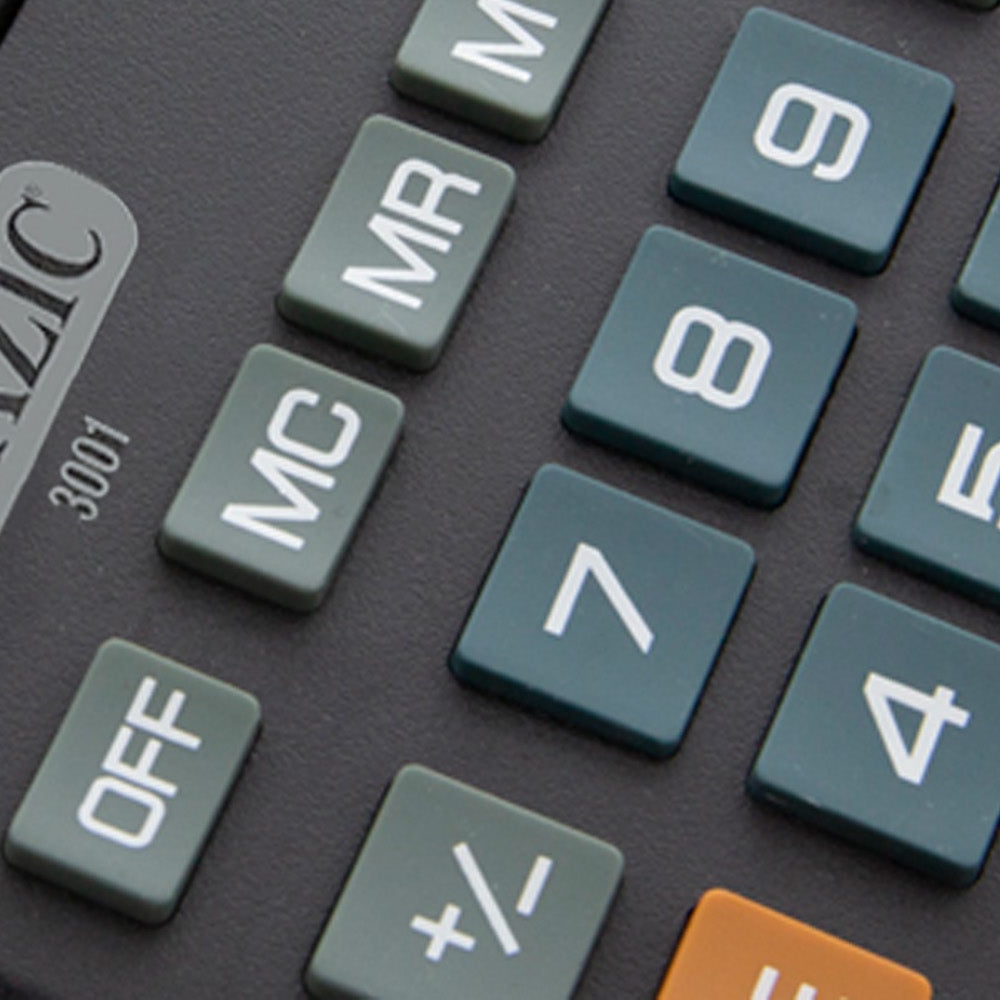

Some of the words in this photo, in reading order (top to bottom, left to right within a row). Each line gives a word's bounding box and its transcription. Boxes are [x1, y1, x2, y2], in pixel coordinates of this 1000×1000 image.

[753, 82, 870, 182] 9
[342, 157, 482, 309] MR
[653, 305, 772, 410] 8
[48, 415, 130, 522] 3001
[220, 387, 362, 551] MC
[543, 541, 654, 654] 7
[77, 676, 202, 849] OFF
[862, 671, 971, 786] 4
